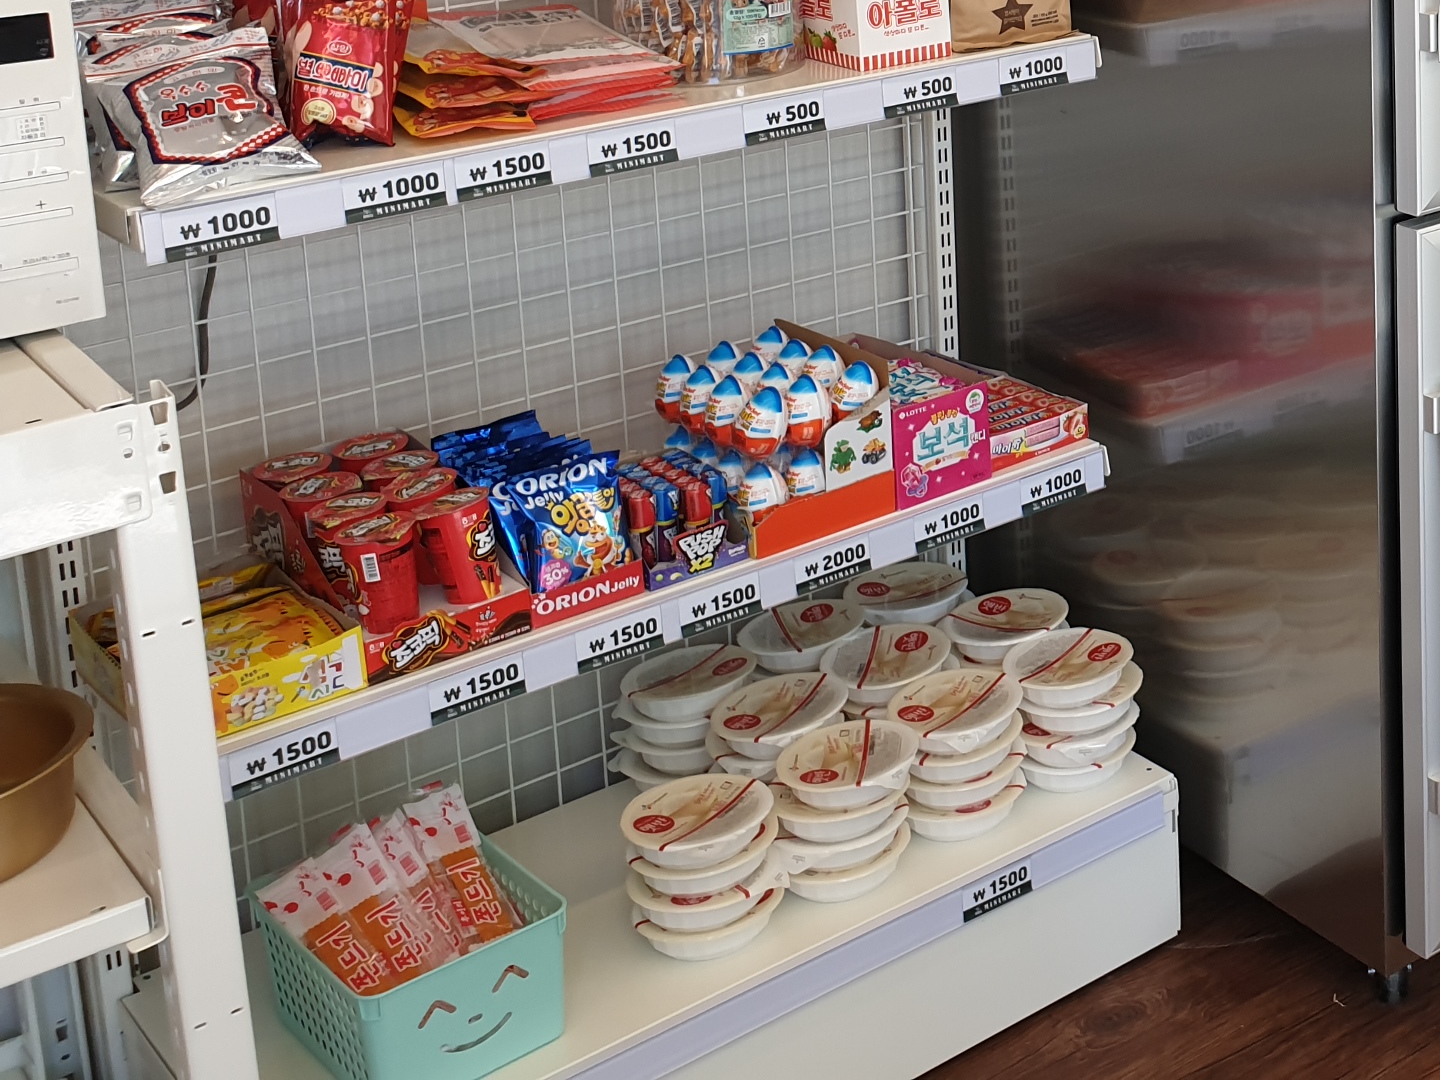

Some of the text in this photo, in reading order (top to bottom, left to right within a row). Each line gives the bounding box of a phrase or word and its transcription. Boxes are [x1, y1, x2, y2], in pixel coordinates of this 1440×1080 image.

[905, 407, 927, 417] LOTTE
[917, 417, 986, 462] 보석 캔디
[515, 457, 608, 496] ORION
[524, 491, 564, 510] Jelly
[679, 525, 725, 546] PUSH
[686, 539, 721, 559] POP
[536, 575, 639, 615] ORION Jelly
